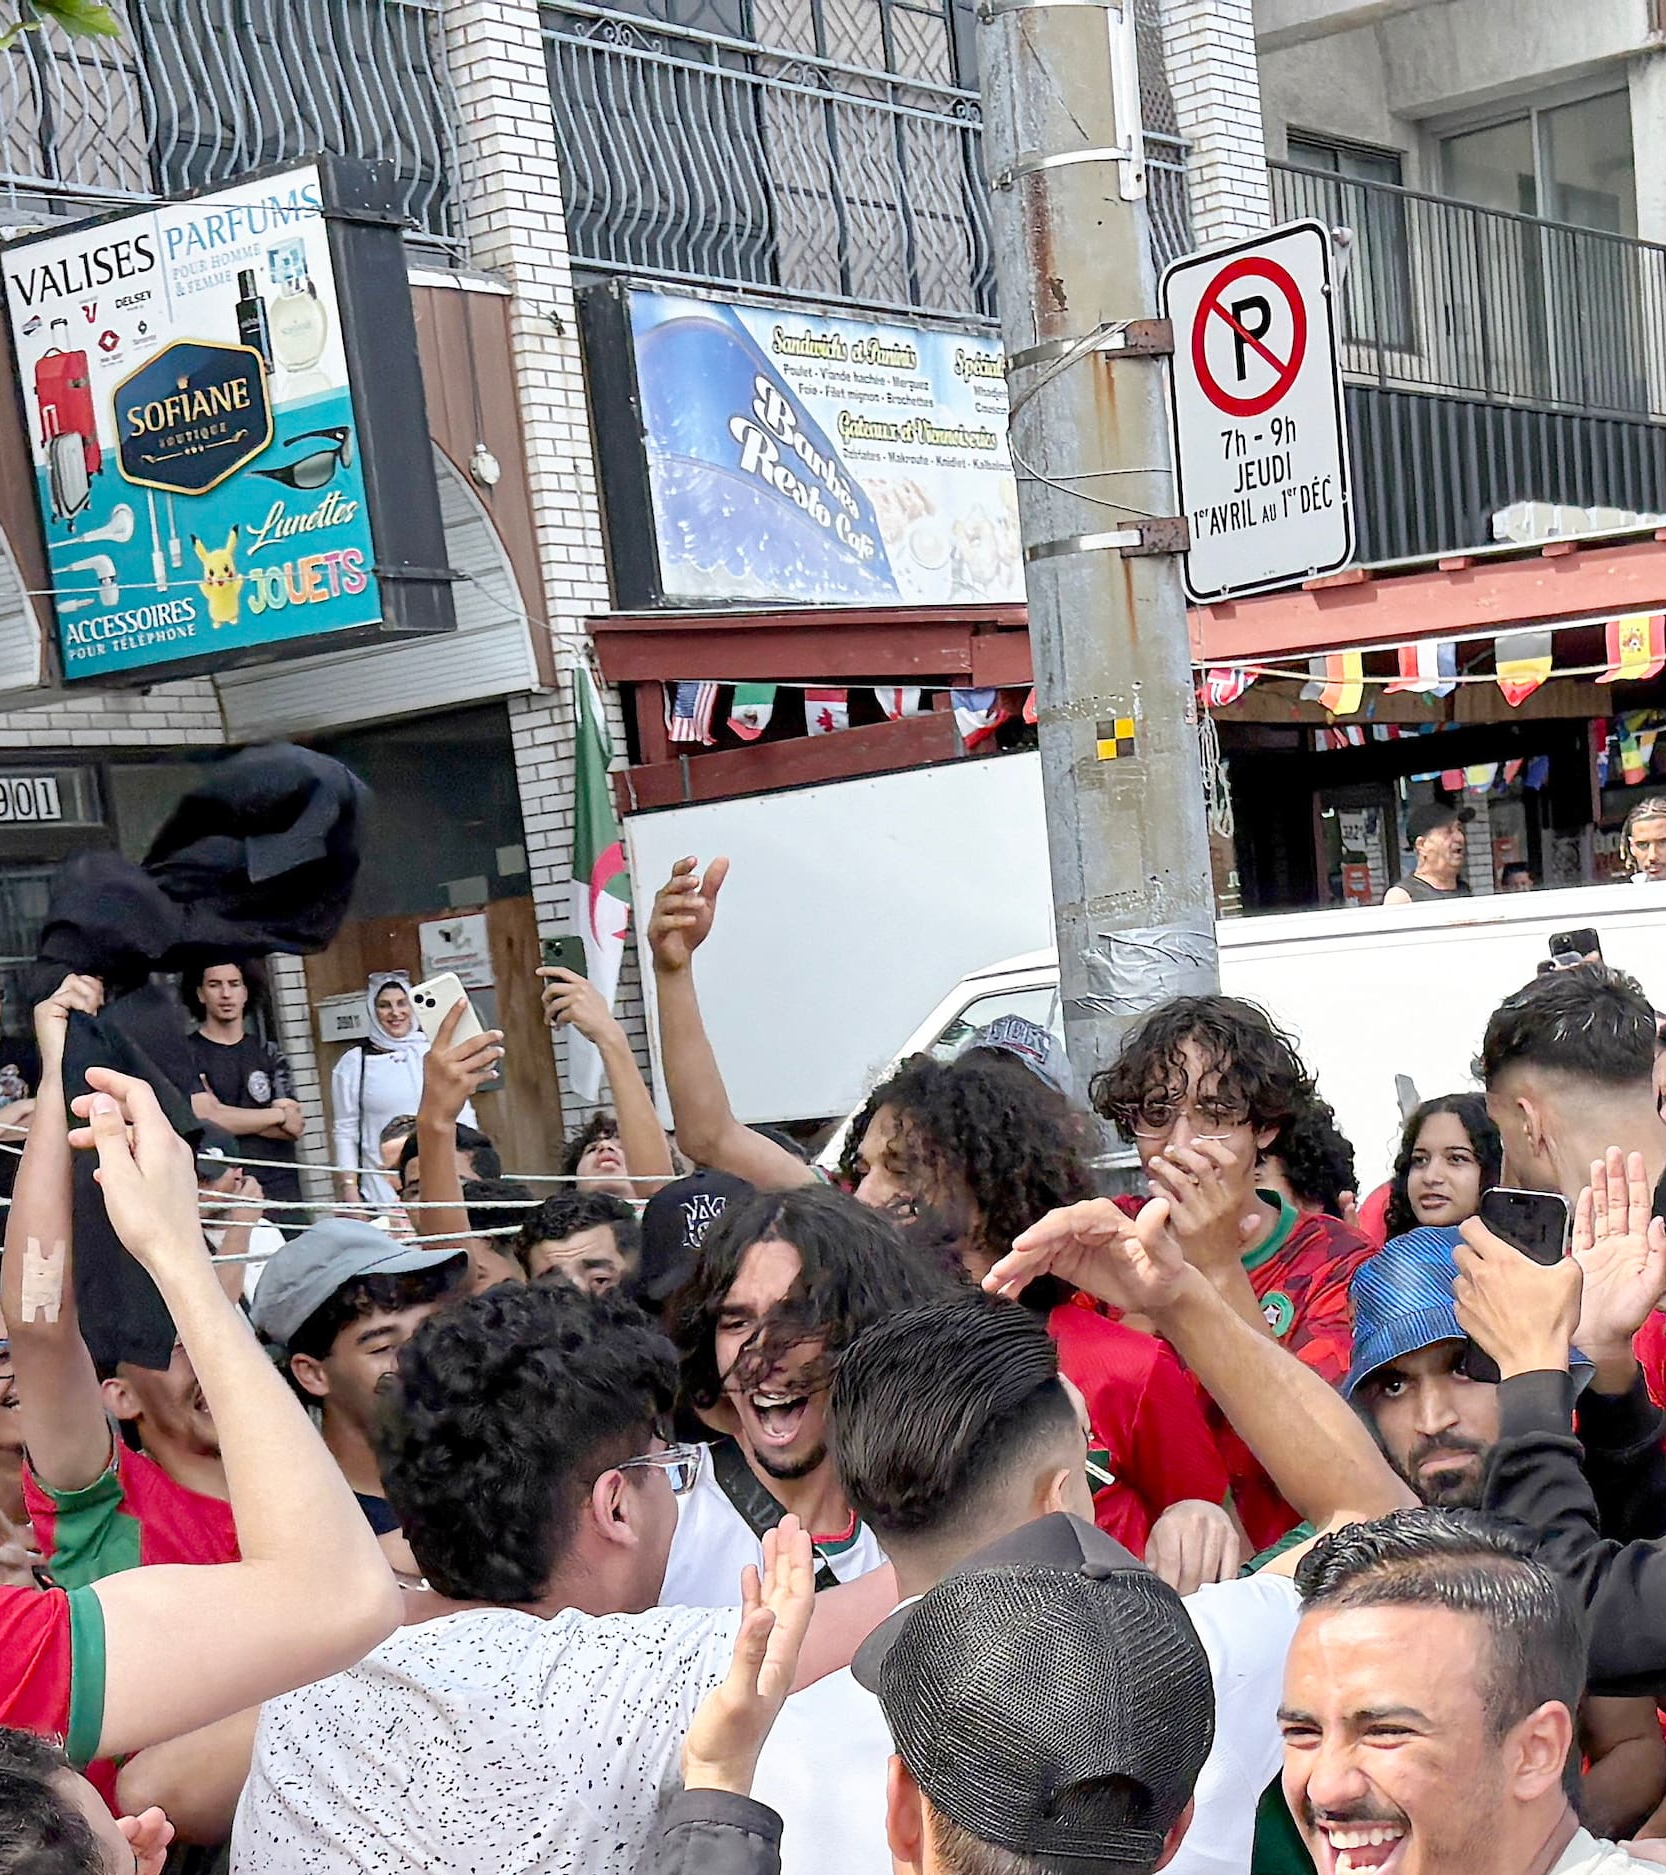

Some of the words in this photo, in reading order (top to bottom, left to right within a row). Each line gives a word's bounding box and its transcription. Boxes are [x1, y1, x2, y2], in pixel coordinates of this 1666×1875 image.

[164, 184, 321, 260] PARFUMS
[11, 234, 155, 306] VALISES
[173, 256, 209, 281] POUR
[211, 243, 261, 271] HOMME
[188, 270, 234, 293] FEMME
[114, 290, 152, 309] DELSEY
[127, 377, 251, 437] SOFIANE
[158, 421, 227, 449] BOUTIQUE
[1221, 430, 1247, 460] 7h
[1271, 416, 1296, 447] 9h
[729, 416, 831, 528] Resto
[835, 512, 874, 560] Café
[1234, 452, 1292, 494] JEUDI
[246, 490, 359, 556] Lunettes
[1193, 508, 1209, 540] 1er
[1210, 498, 1257, 537] AVRIL
[1262, 503, 1277, 524] AU
[1281, 486, 1297, 519] 1er
[1300, 474, 1334, 514] DÉC
[247, 548, 367, 614] JOUETS
[66, 597, 197, 646] ACCESSOIRES
[68, 641, 106, 661] POUR
